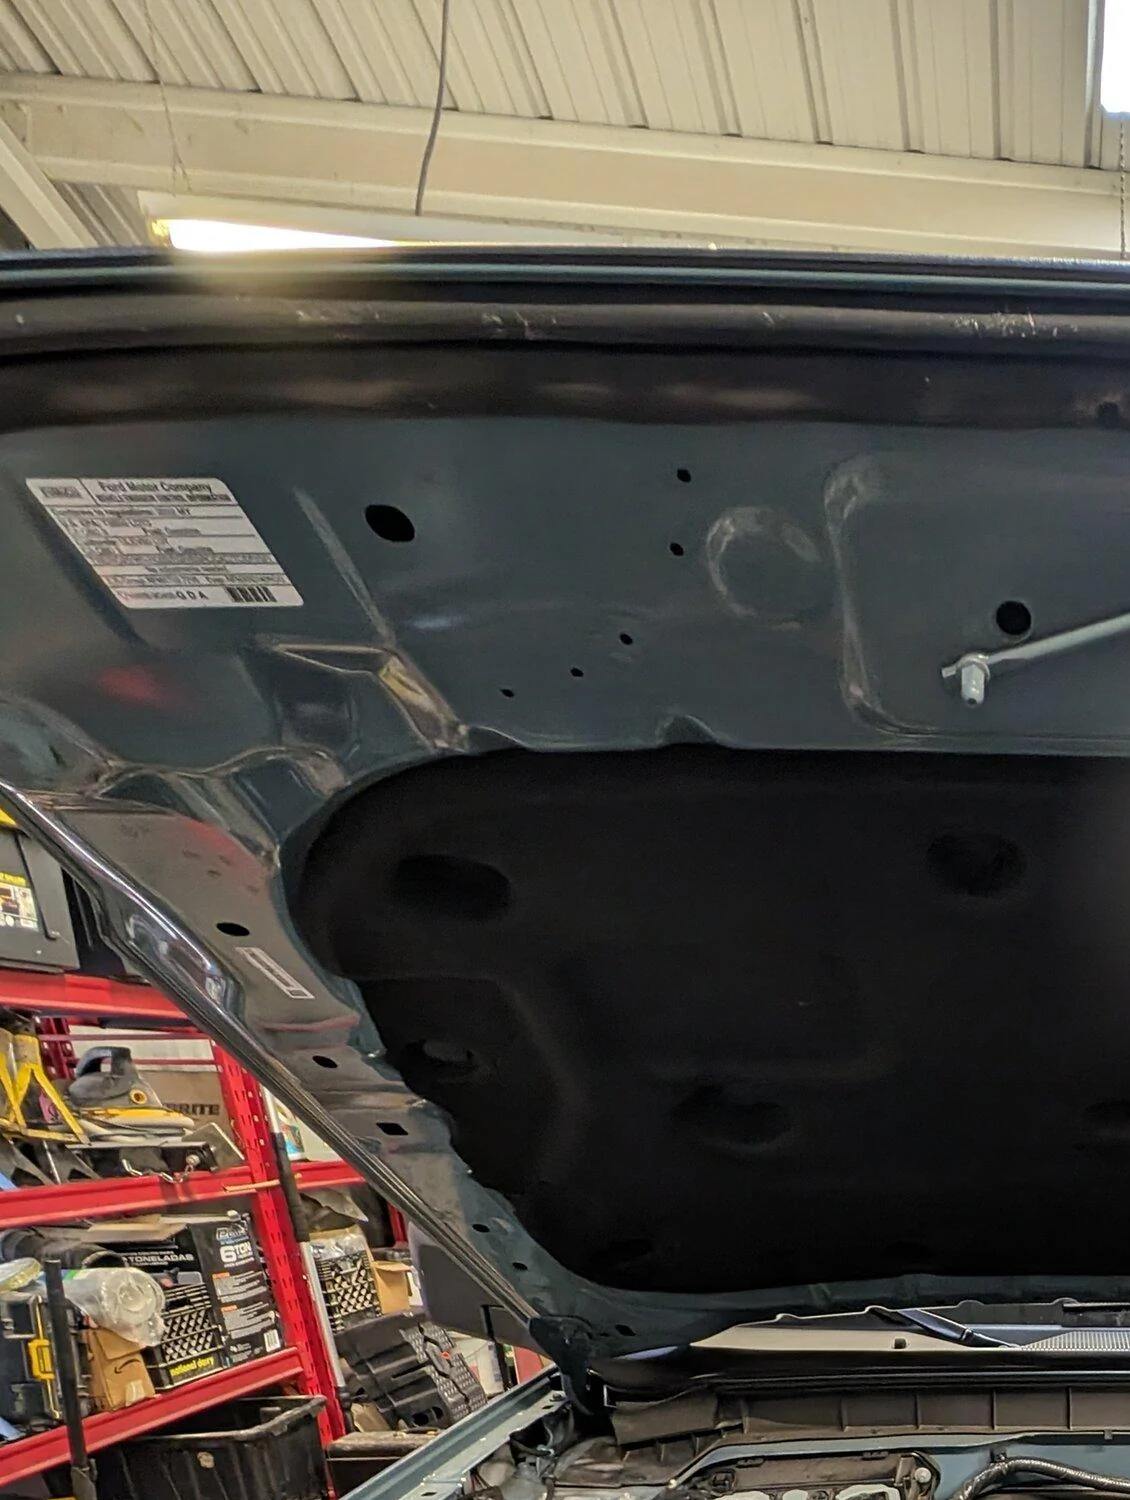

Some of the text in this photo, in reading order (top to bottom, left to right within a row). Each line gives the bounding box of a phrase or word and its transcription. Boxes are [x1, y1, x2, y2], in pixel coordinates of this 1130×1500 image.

[100, 481, 213, 494] Ford Motor Company
[129, 1253, 194, 1263] TONELADAS
[220, 1245, 237, 1263] 6
